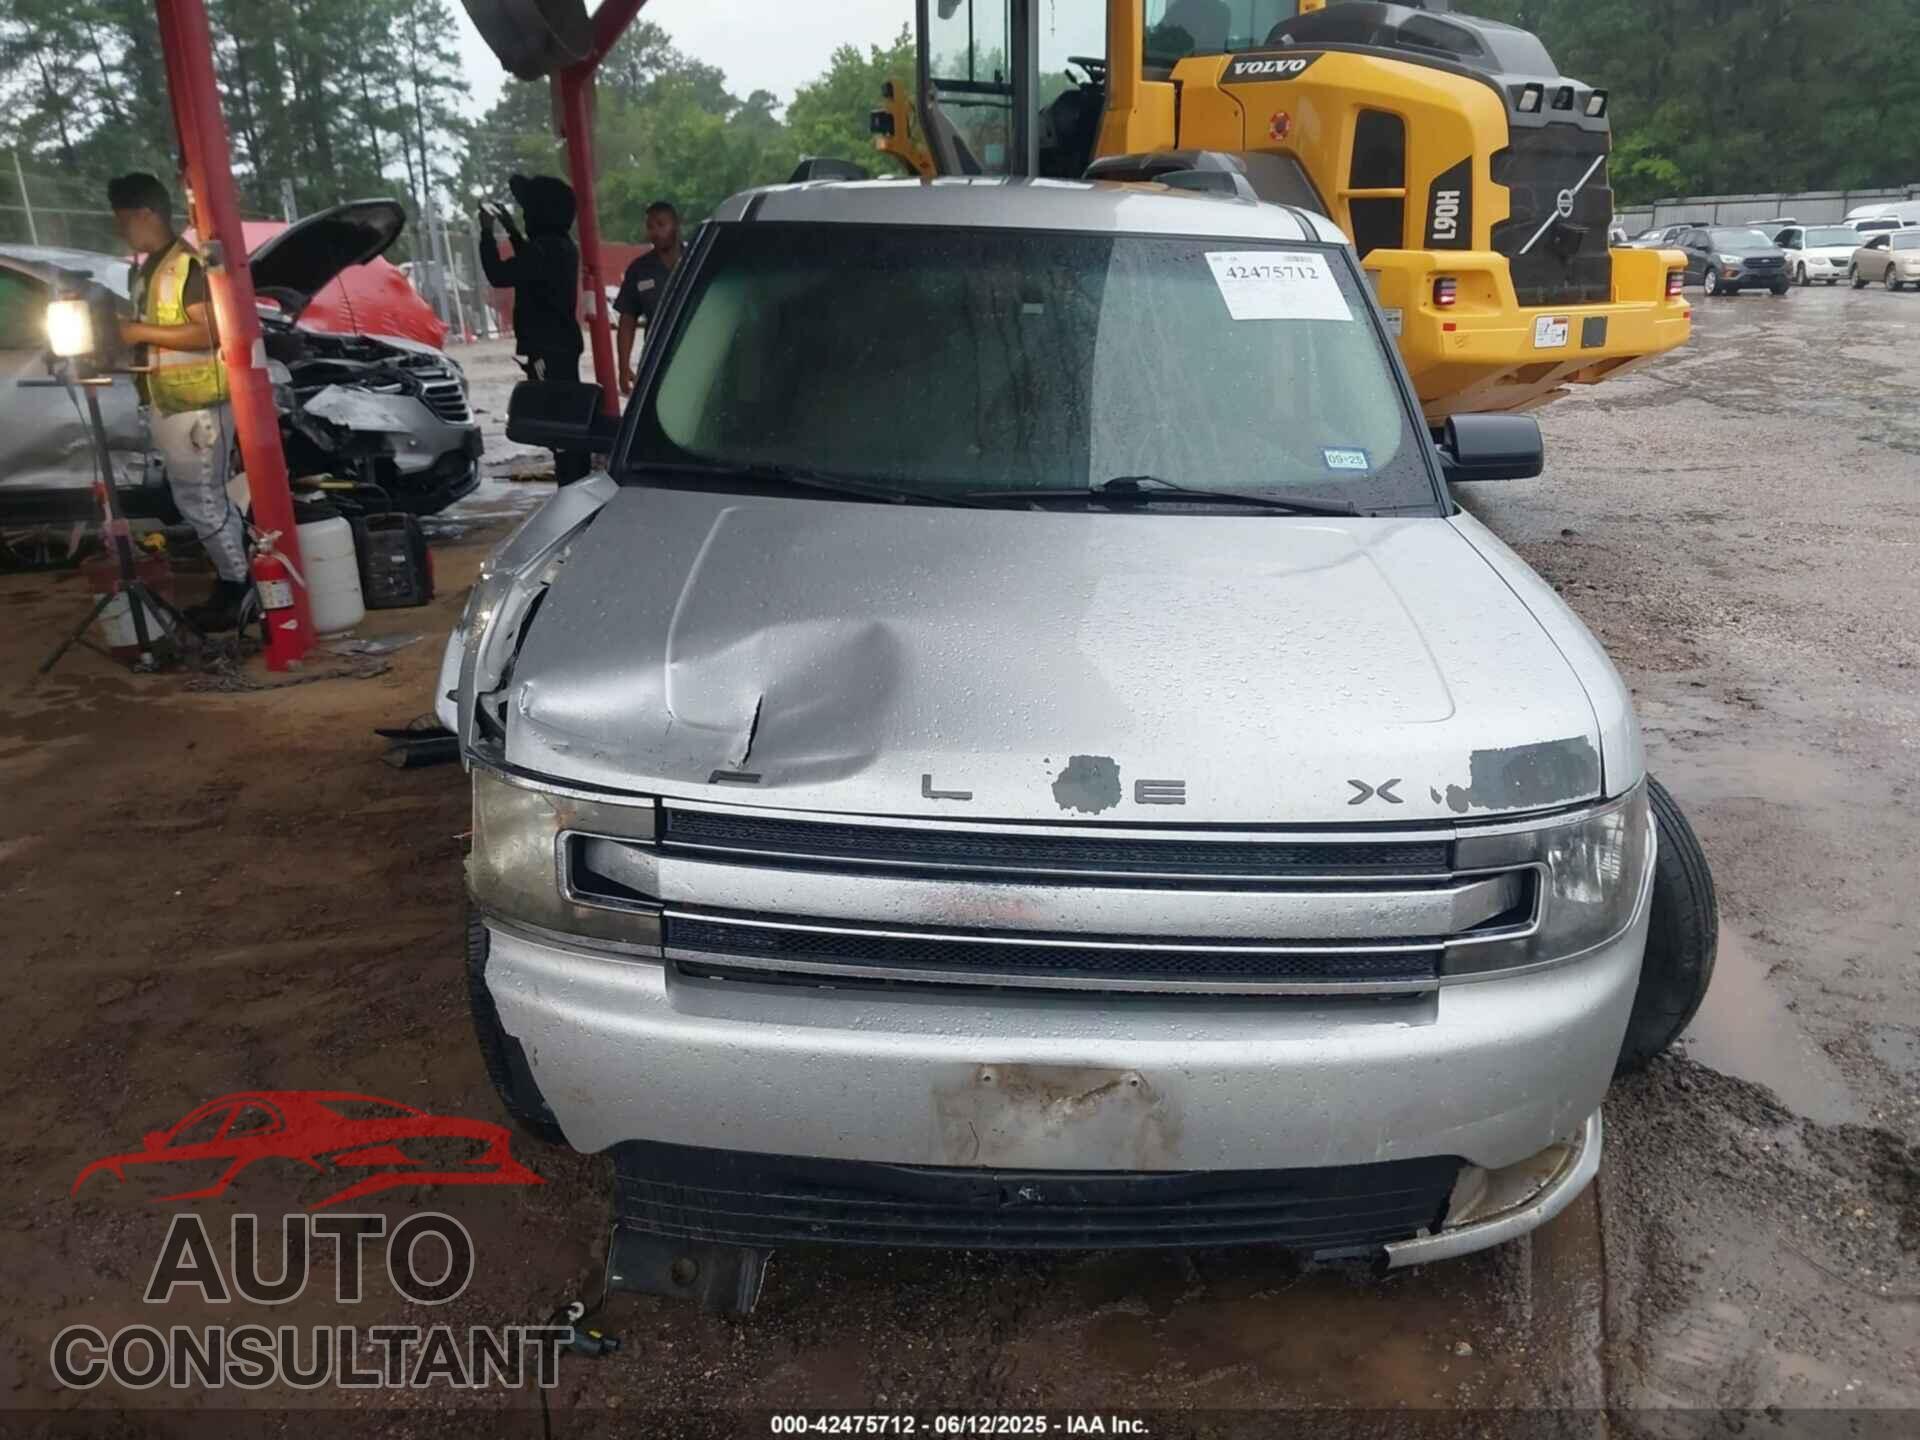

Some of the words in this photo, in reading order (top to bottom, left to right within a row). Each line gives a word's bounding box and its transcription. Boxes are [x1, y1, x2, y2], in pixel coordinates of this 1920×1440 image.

[1234, 59, 1307, 74] VOLVO
[1432, 190, 1460, 239] L90H
[1226, 265, 1319, 279] 42475712
